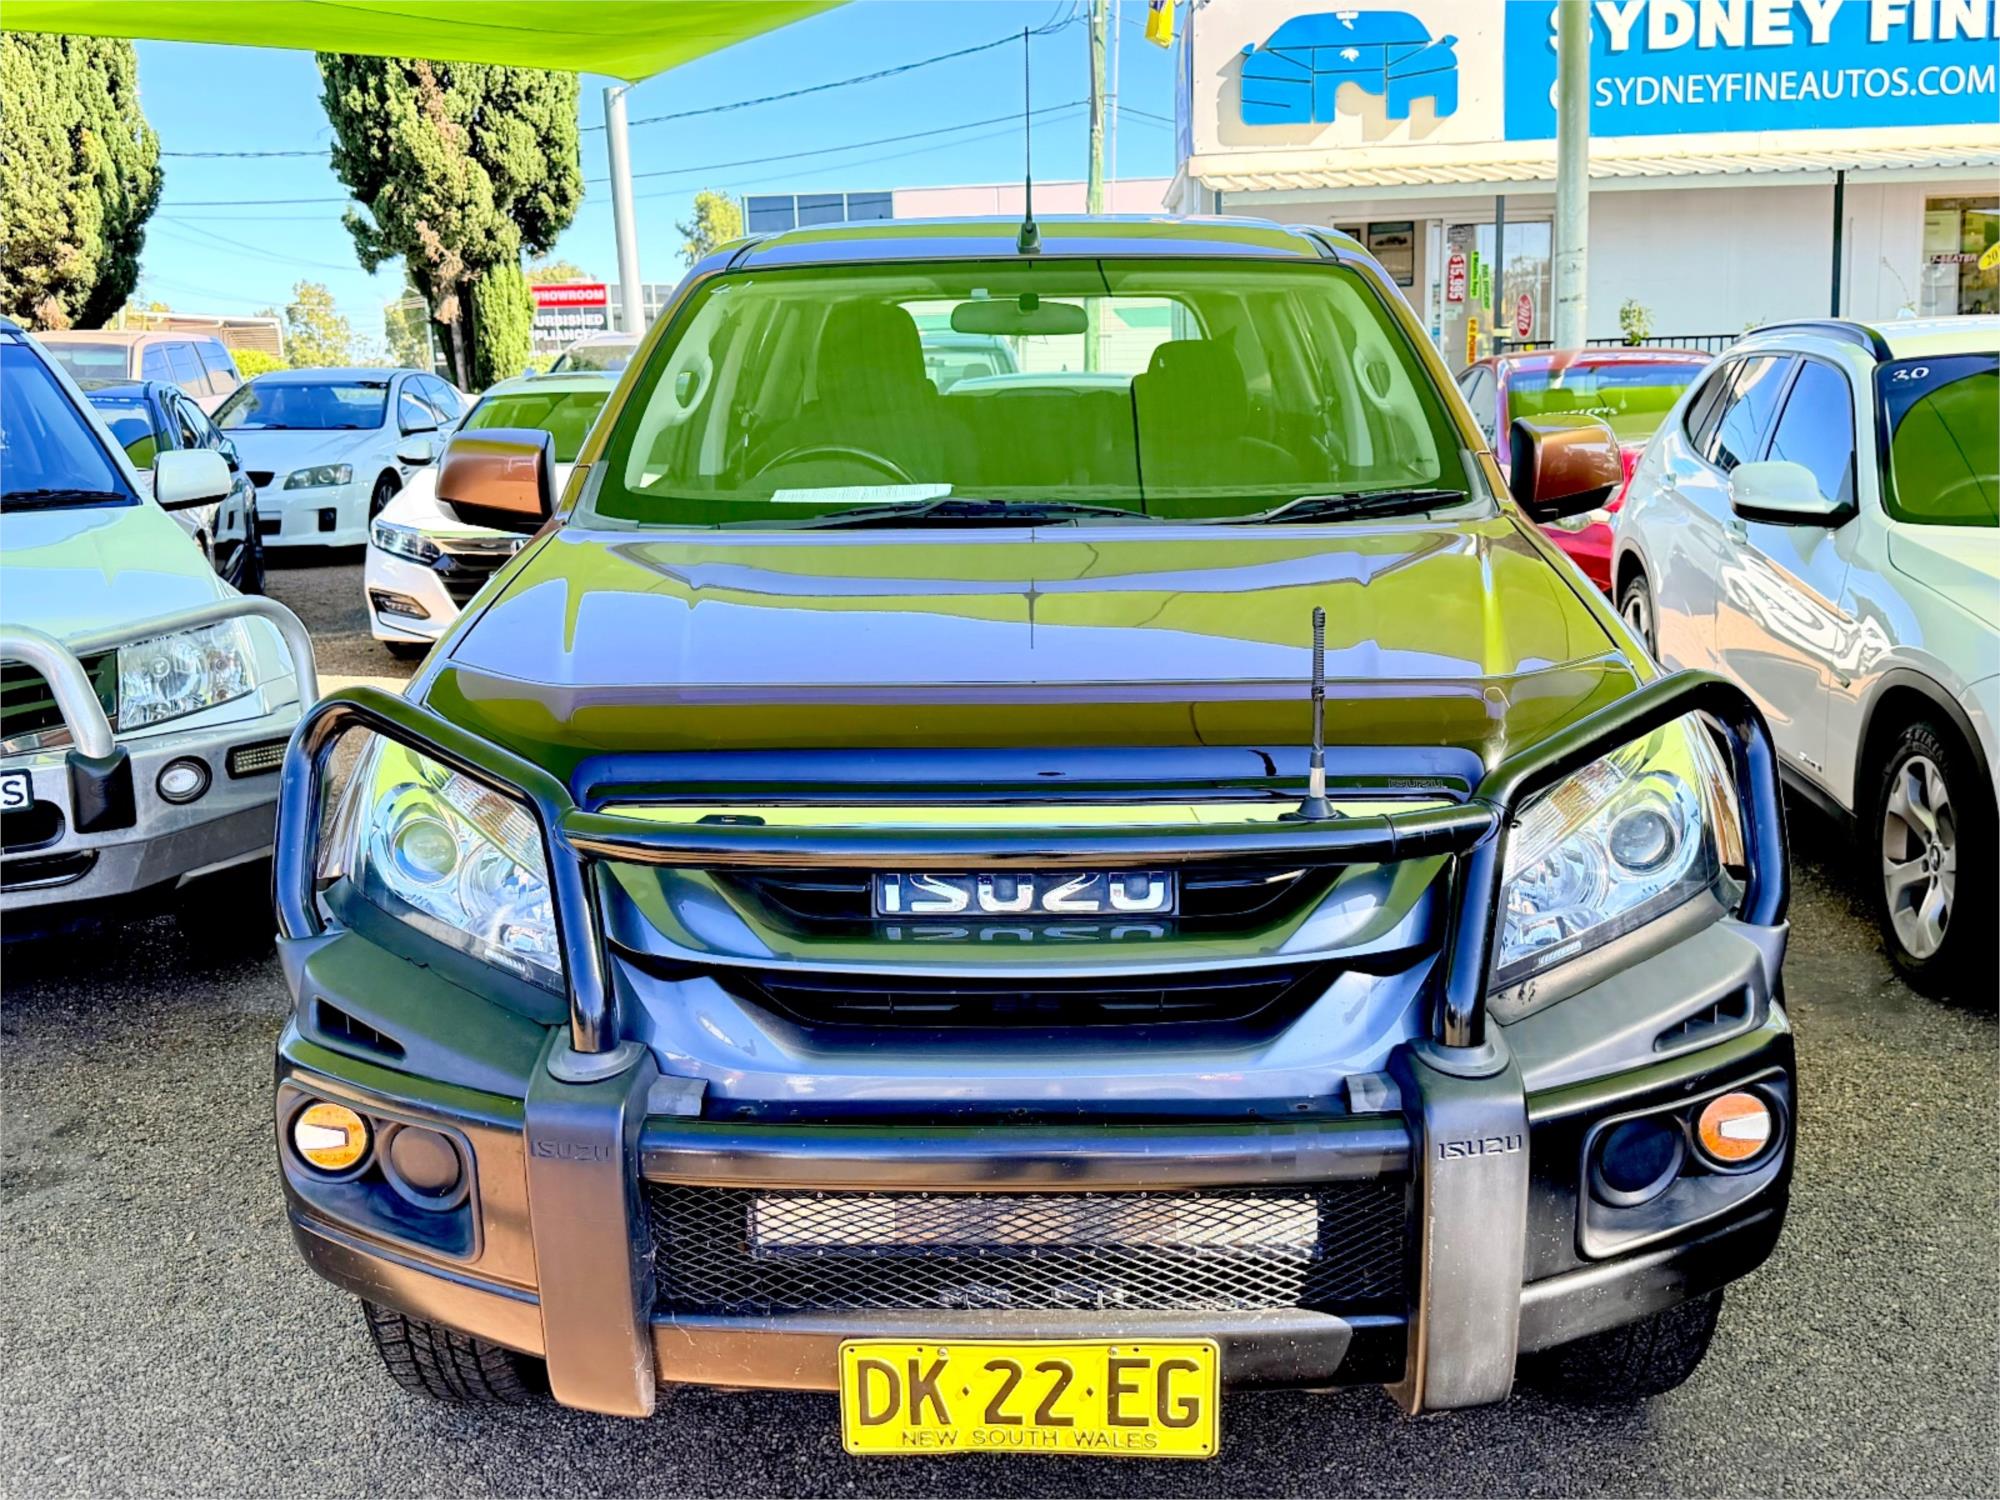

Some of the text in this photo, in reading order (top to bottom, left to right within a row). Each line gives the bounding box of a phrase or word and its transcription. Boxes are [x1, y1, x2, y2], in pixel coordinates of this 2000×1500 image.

[1870, 0, 2000, 42] FIN
[1595, 65, 1996, 107] SYDNEYFINEAUTOS.COM
[534, 313, 604, 327] URBISHED
[884, 872, 1171, 912] ISUZU
[530, 1140, 609, 1160] ISUZU
[1438, 1135, 1522, 1160] ISUZU
[901, 1430, 1159, 1449] NEW SOUTH WALES
